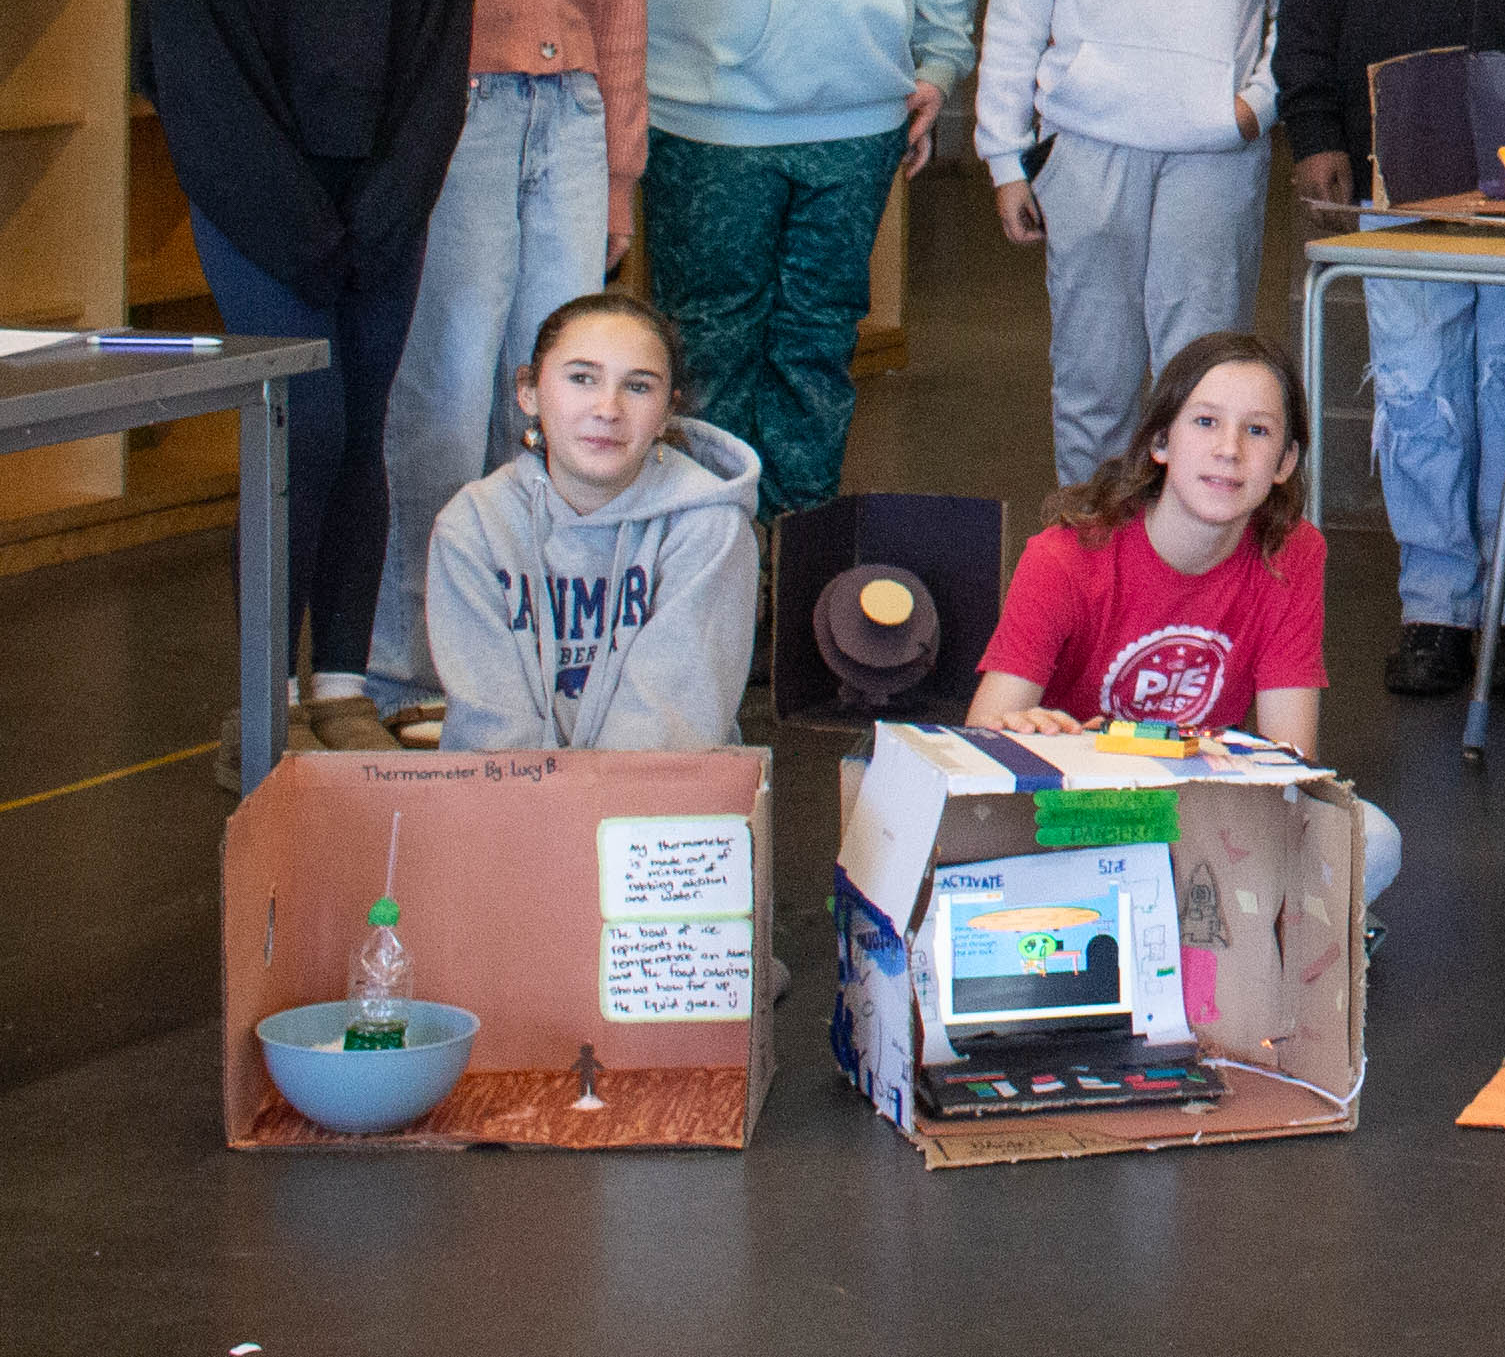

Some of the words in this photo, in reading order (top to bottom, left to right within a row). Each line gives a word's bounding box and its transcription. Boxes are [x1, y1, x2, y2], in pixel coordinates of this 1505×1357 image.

[1133, 661, 1211, 702] PIE
[362, 763, 479, 782] Thermometer
[510, 759, 543, 782] Lucy
[938, 873, 1005, 891] ACTIVATE
[639, 925, 668, 938] bowl
